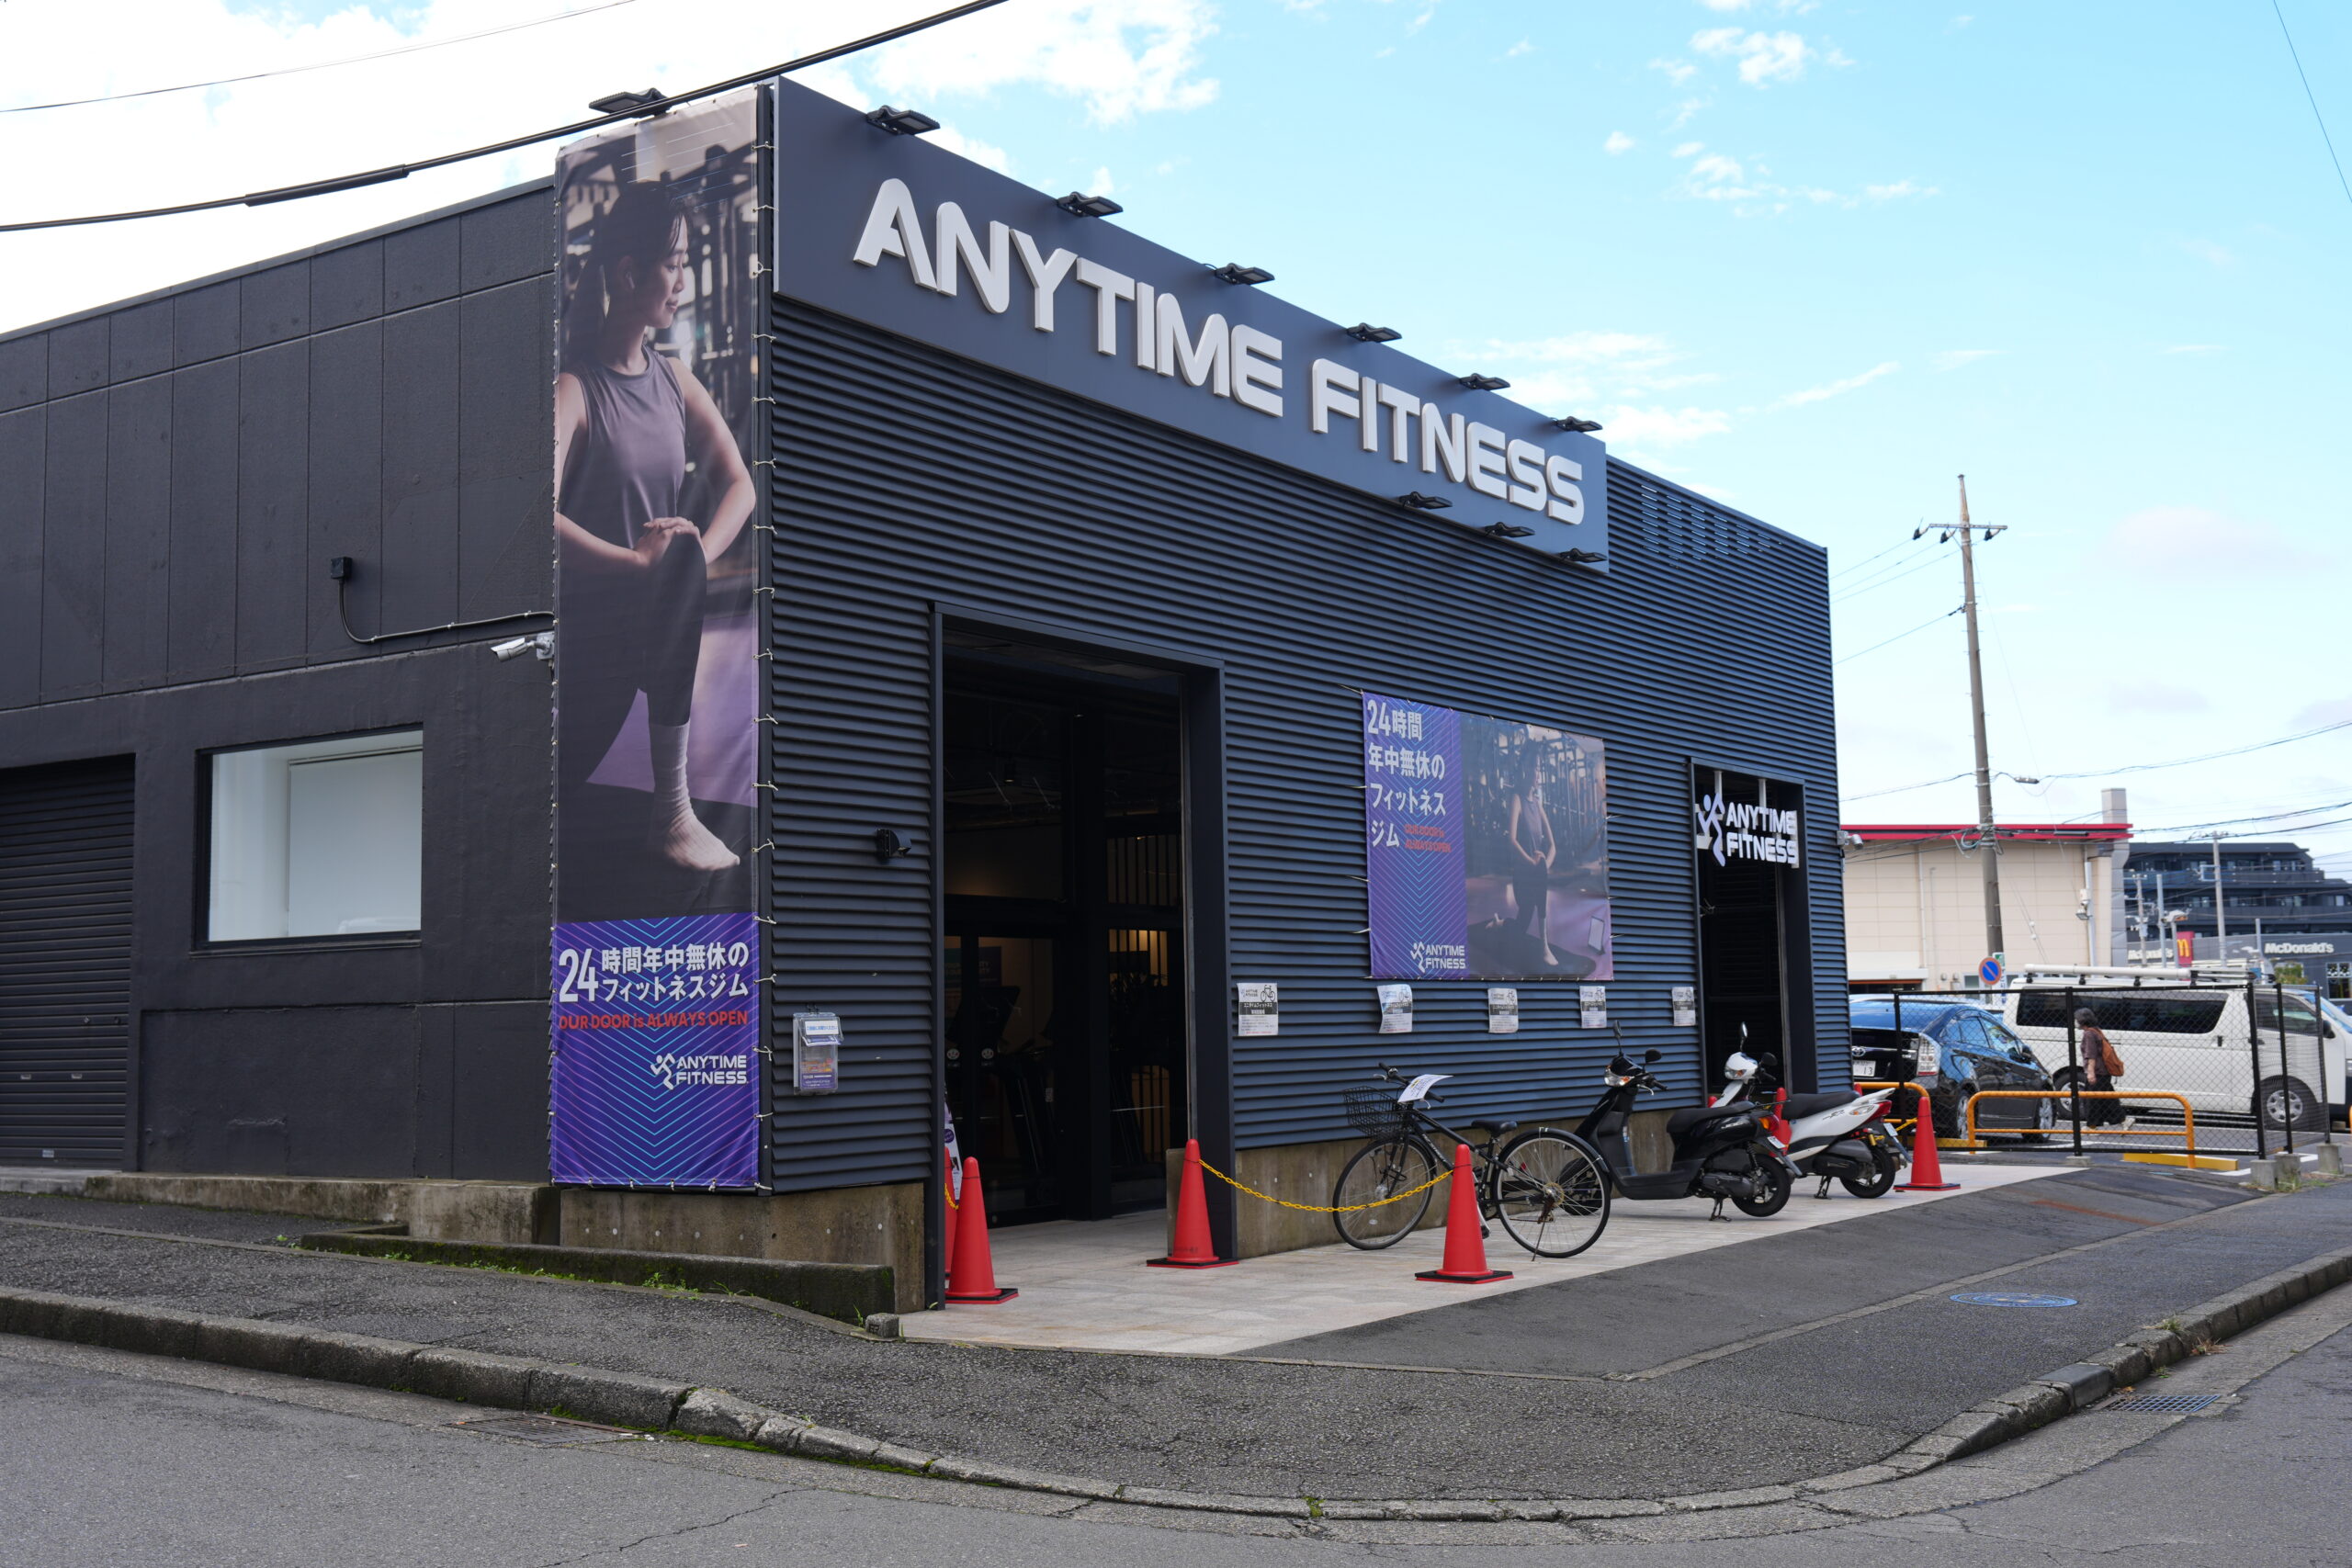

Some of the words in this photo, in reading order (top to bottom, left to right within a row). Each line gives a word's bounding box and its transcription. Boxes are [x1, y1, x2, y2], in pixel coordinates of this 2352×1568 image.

[853, 178, 1284, 418] ANYTIME
[1311, 357, 1586, 526] FITNESS
[1367, 699, 1422, 741] 24時間
[1368, 742, 1445, 780] 年中無休の
[1370, 783, 1446, 817] フィットネス
[1371, 819, 1400, 848] ジム
[1726, 802, 1797, 835] ANYTIME
[1726, 832, 1798, 863] FITNESS
[1426, 944, 1465, 956] ANYTIME
[2265, 942, 2335, 954] McDonald's
[559, 948, 599, 1003] 24
[602, 942, 750, 975] 時間年中無休の
[1426, 958, 1466, 970] FITNESS
[603, 972, 749, 1003] フィットネスジム
[560, 1014, 589, 1030] OUR
[591, 1013, 630, 1029] DOOR
[633, 1012, 645, 1028] is
[648, 1011, 707, 1027] ALWAYS
[708, 1010, 749, 1025] OPEN
[676, 1055, 747, 1069] ANYTIME
[676, 1071, 747, 1085] FITNESS
